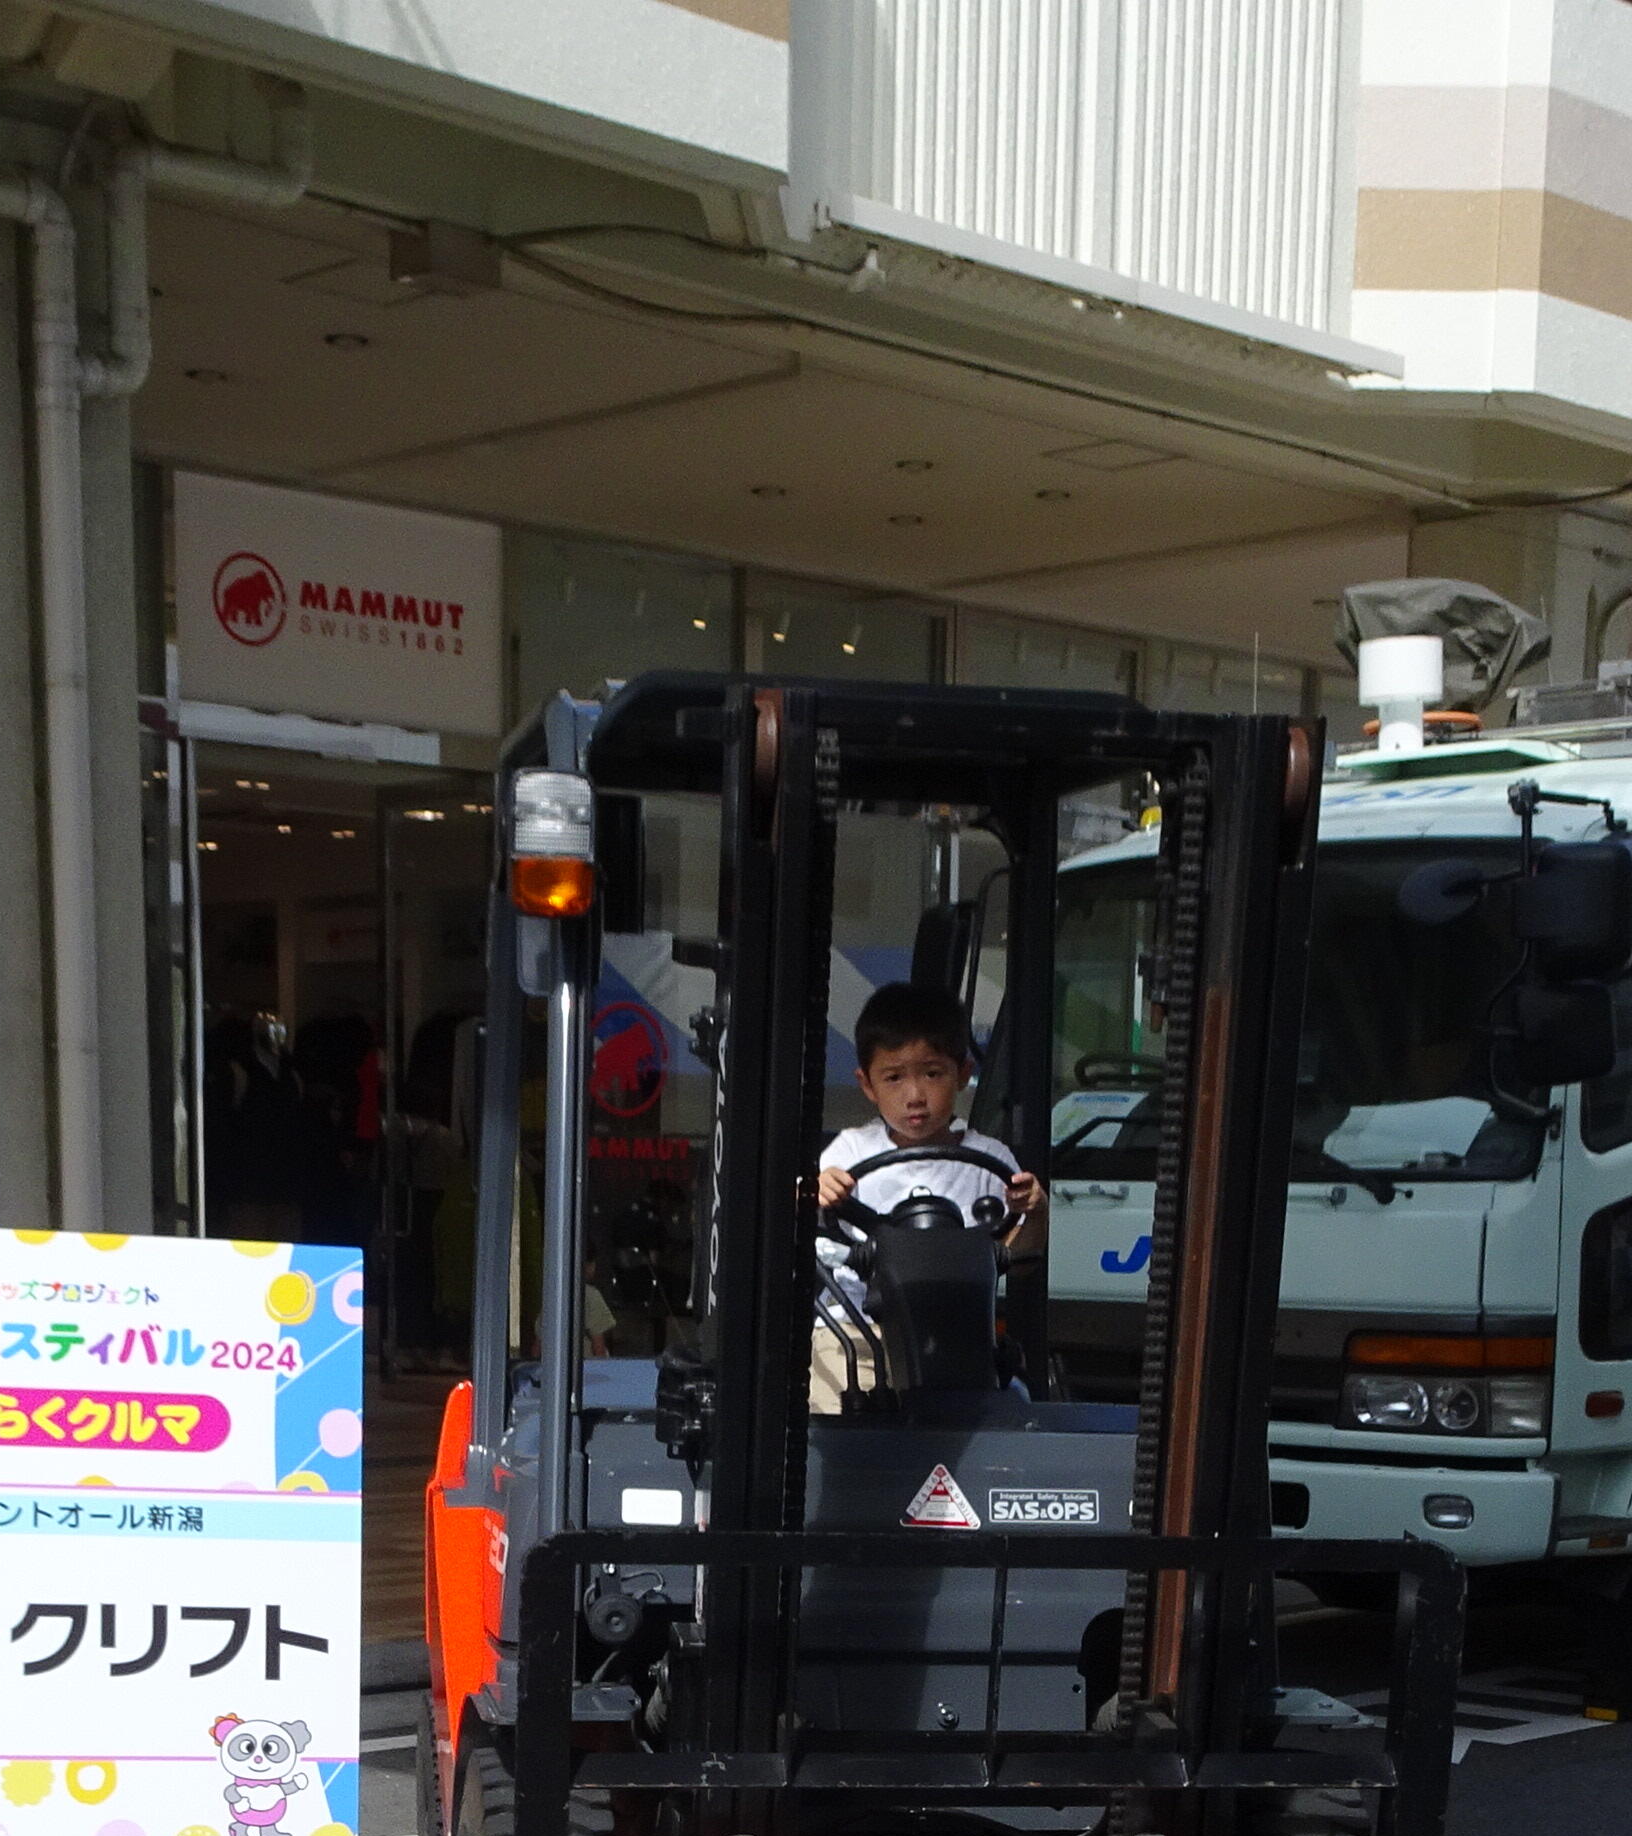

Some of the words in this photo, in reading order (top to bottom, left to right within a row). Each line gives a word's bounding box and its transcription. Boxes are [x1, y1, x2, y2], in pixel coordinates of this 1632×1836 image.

[300, 580, 464, 631] MAMMUT
[588, 1137, 690, 1160] AMMUT
[707, 1027, 728, 1316] TOYOTA
